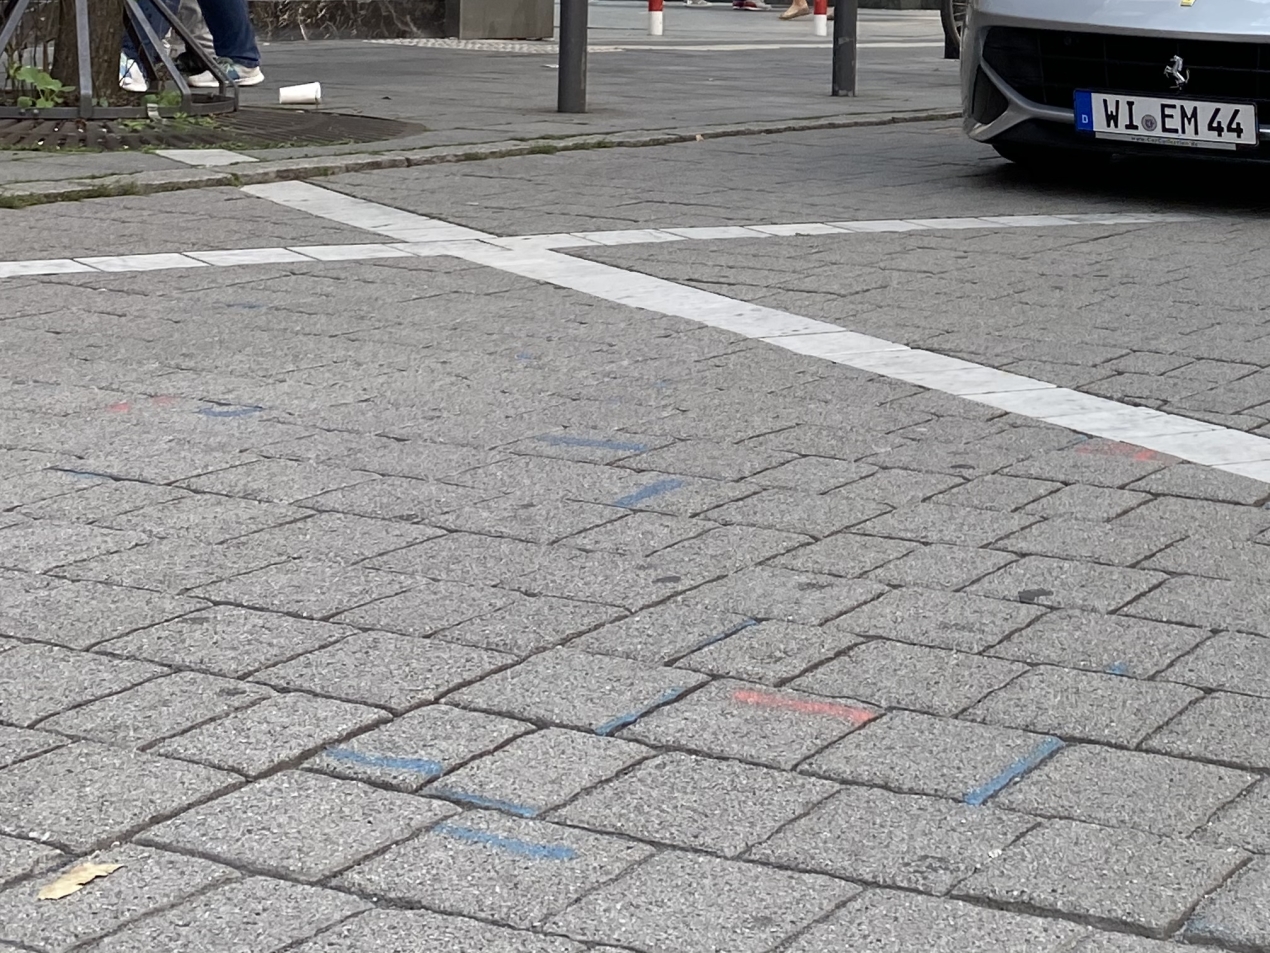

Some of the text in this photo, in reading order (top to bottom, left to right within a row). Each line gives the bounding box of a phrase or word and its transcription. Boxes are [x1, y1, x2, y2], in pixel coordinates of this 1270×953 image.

[1081, 114, 1089, 124] D
[1102, 98, 1244, 139] WI EM 44
